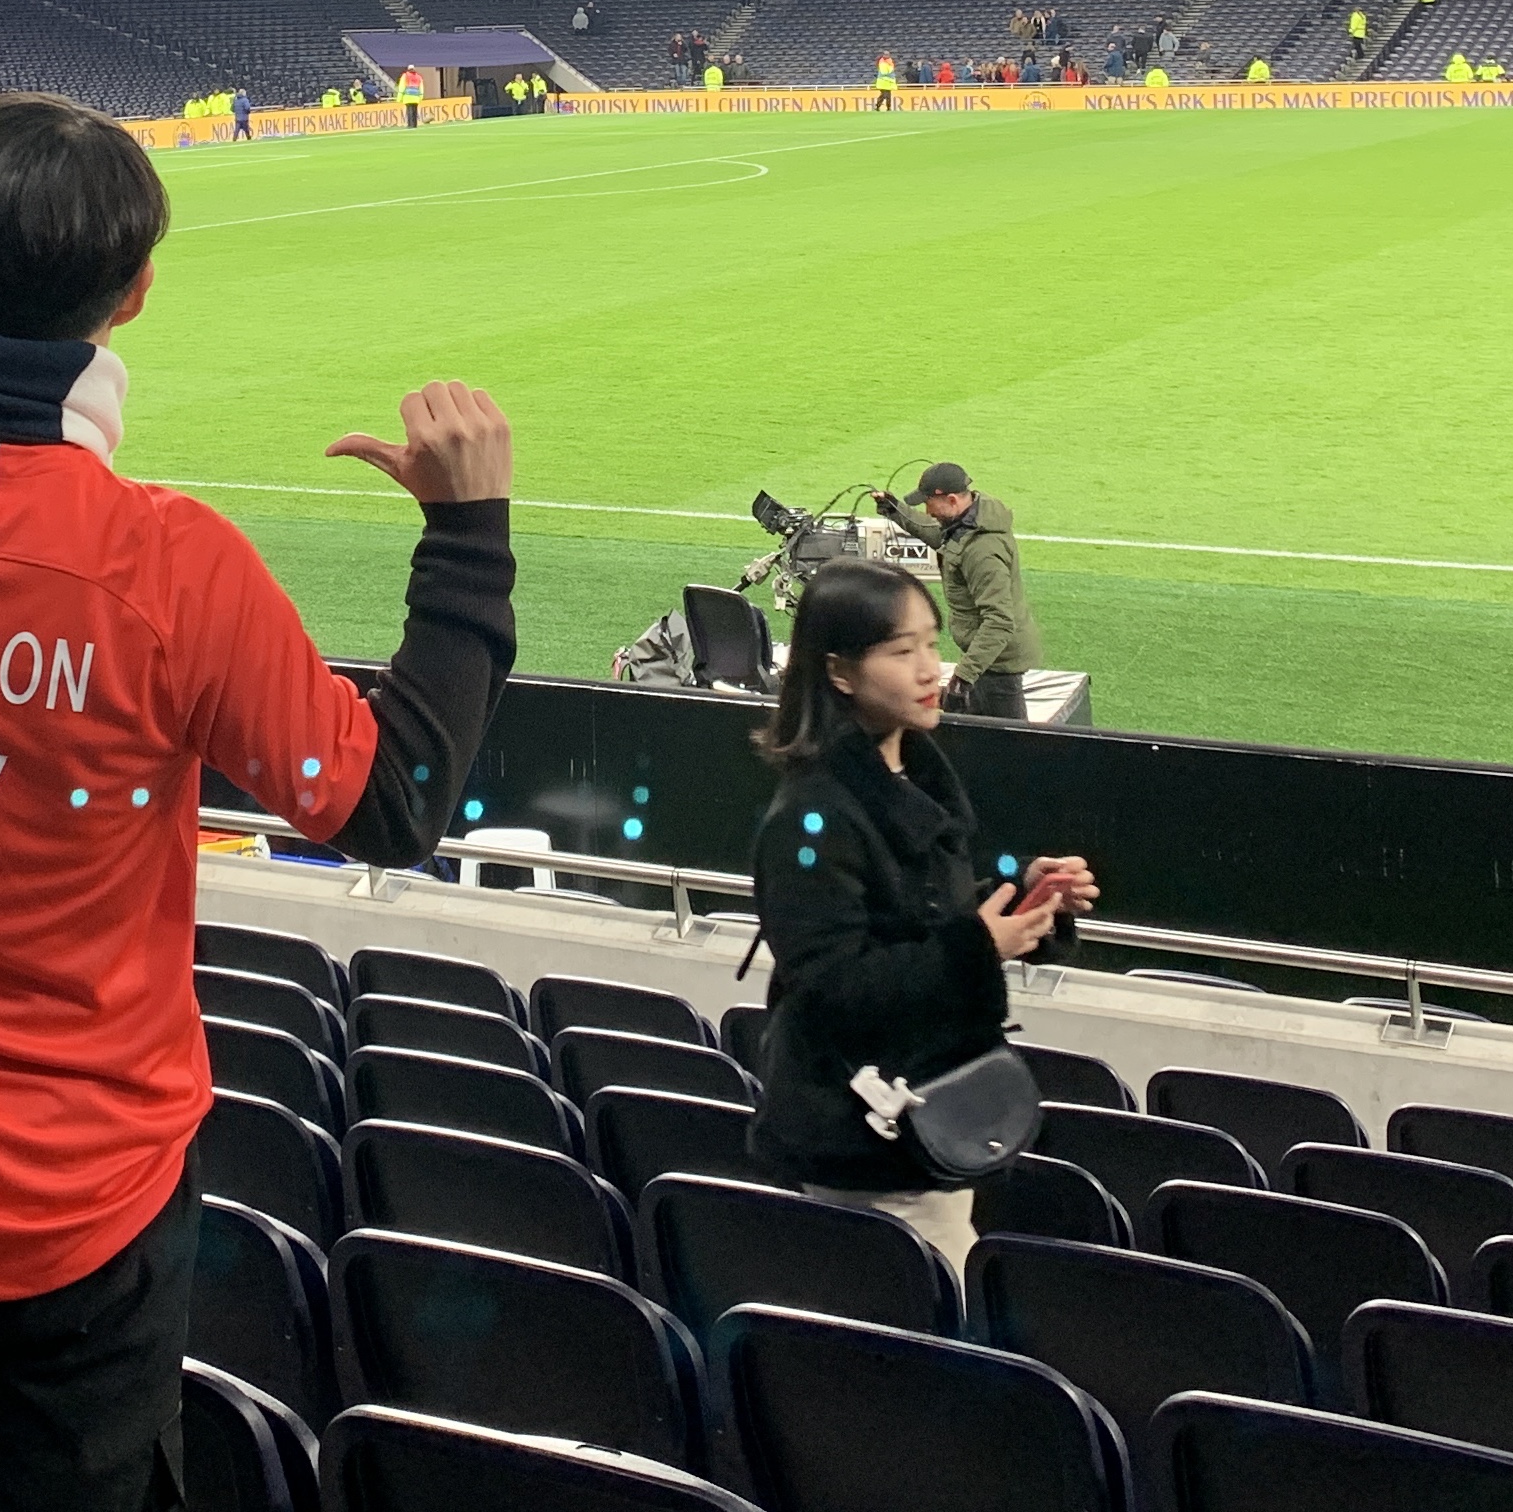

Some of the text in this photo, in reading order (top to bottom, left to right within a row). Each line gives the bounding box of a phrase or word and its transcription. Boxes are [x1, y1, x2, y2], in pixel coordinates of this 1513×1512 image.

[718, 97, 804, 112] CHILDREN
[809, 97, 847, 112] AND
[910, 95, 991, 111] FAMILIES
[1164, 93, 1206, 110] ARK
[1213, 92, 1276, 109] HELPS
[1283, 92, 1342, 109] MAKE
[1350, 90, 1454, 108] PRECIOUS
[257, 118, 280, 136] ARK
[283, 115, 316, 134] HELPS
[318, 112, 348, 131] MAKE
[351, 108, 398, 129] PRECIOUS
